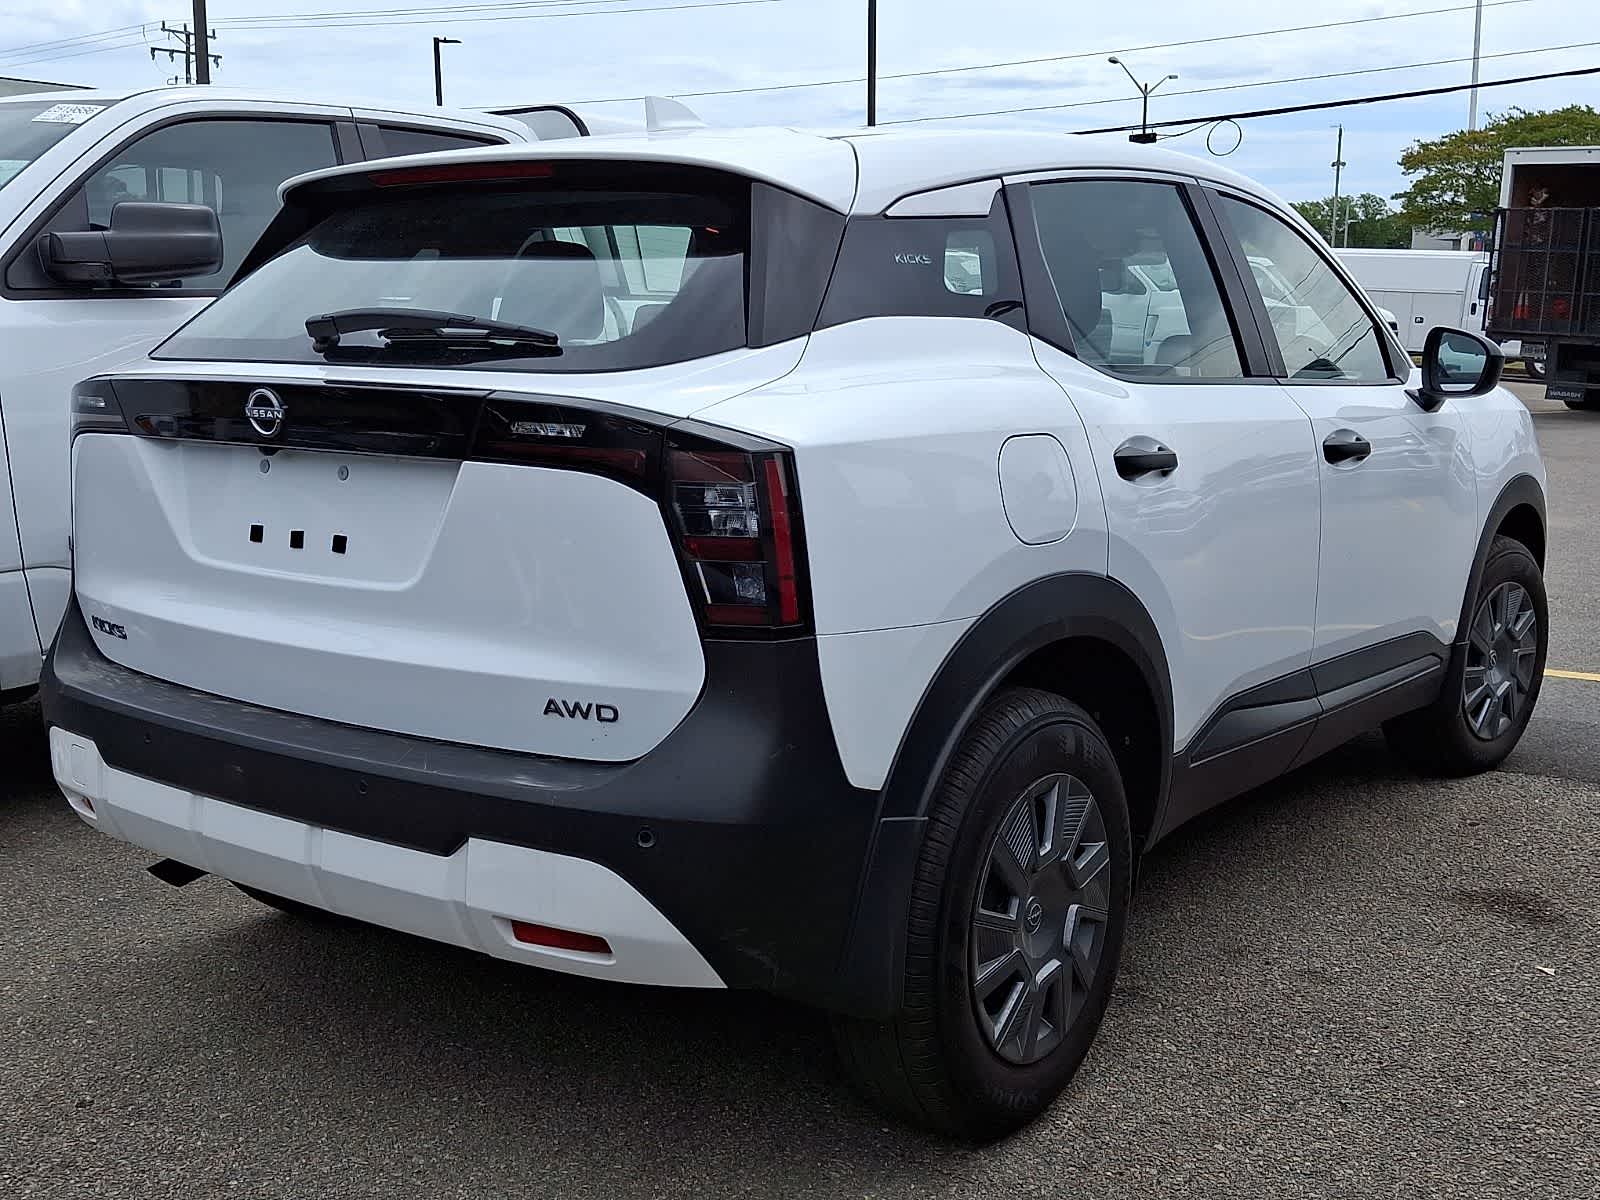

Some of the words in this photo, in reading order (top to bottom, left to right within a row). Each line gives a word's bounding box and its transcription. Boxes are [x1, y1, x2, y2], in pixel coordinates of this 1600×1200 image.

[894, 253, 932, 265] KICKS
[245, 408, 282, 419] NISSAN
[543, 697, 620, 723] AWD
